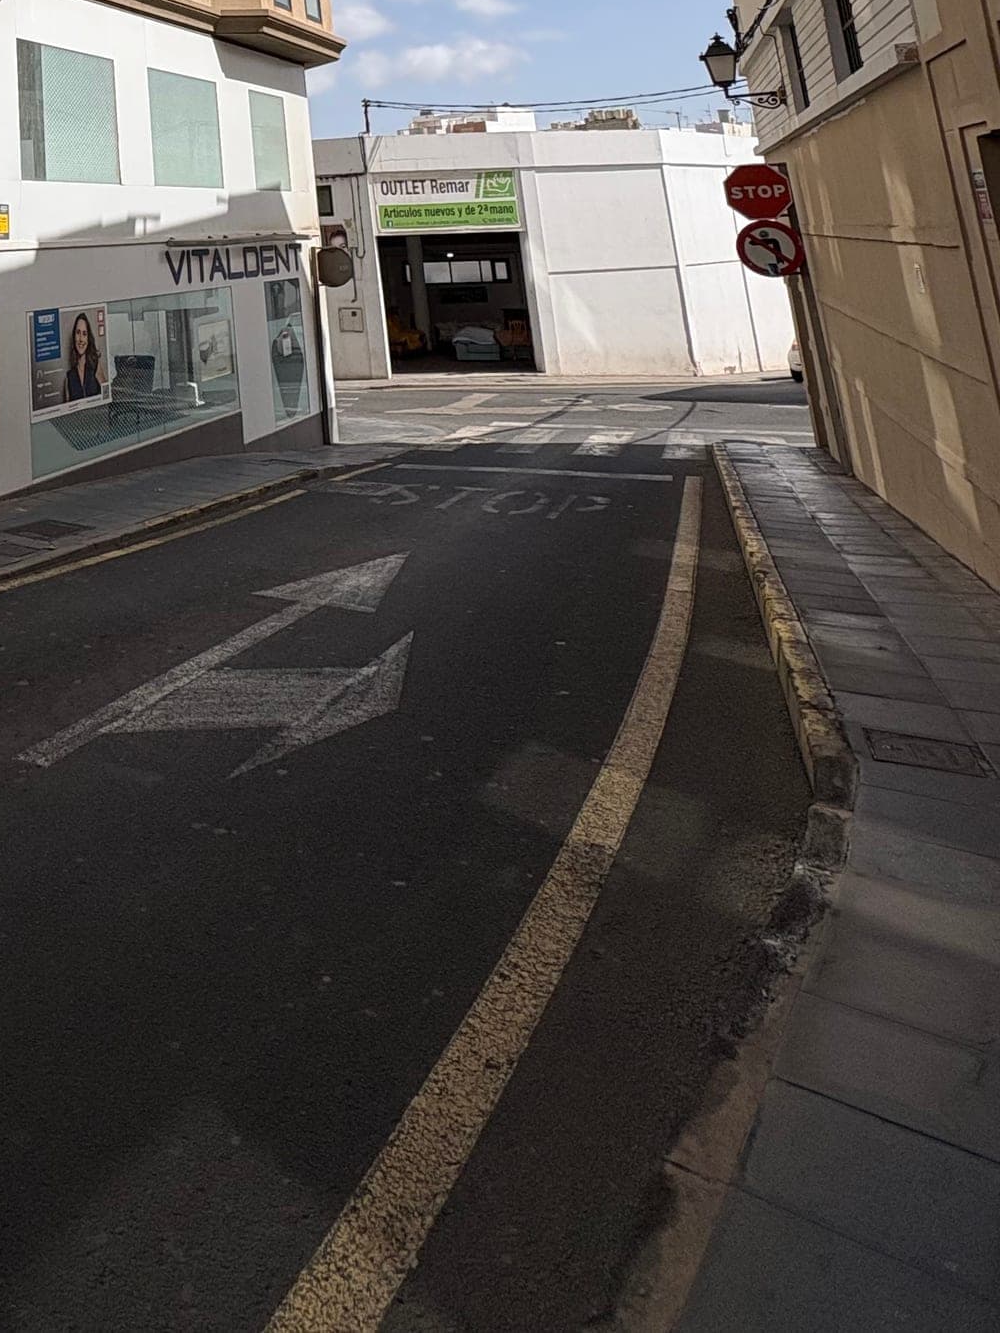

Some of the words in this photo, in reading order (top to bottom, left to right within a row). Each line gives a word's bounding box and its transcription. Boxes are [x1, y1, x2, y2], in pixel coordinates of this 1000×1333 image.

[380, 179, 426, 196] OUTLET
[430, 179, 470, 194] Remar
[731, 184, 786, 199] STOP
[424, 207, 456, 217] nuevos
[465, 205, 476, 215] de
[490, 205, 514, 214] mano
[165, 243, 302, 286] VITALDENT
